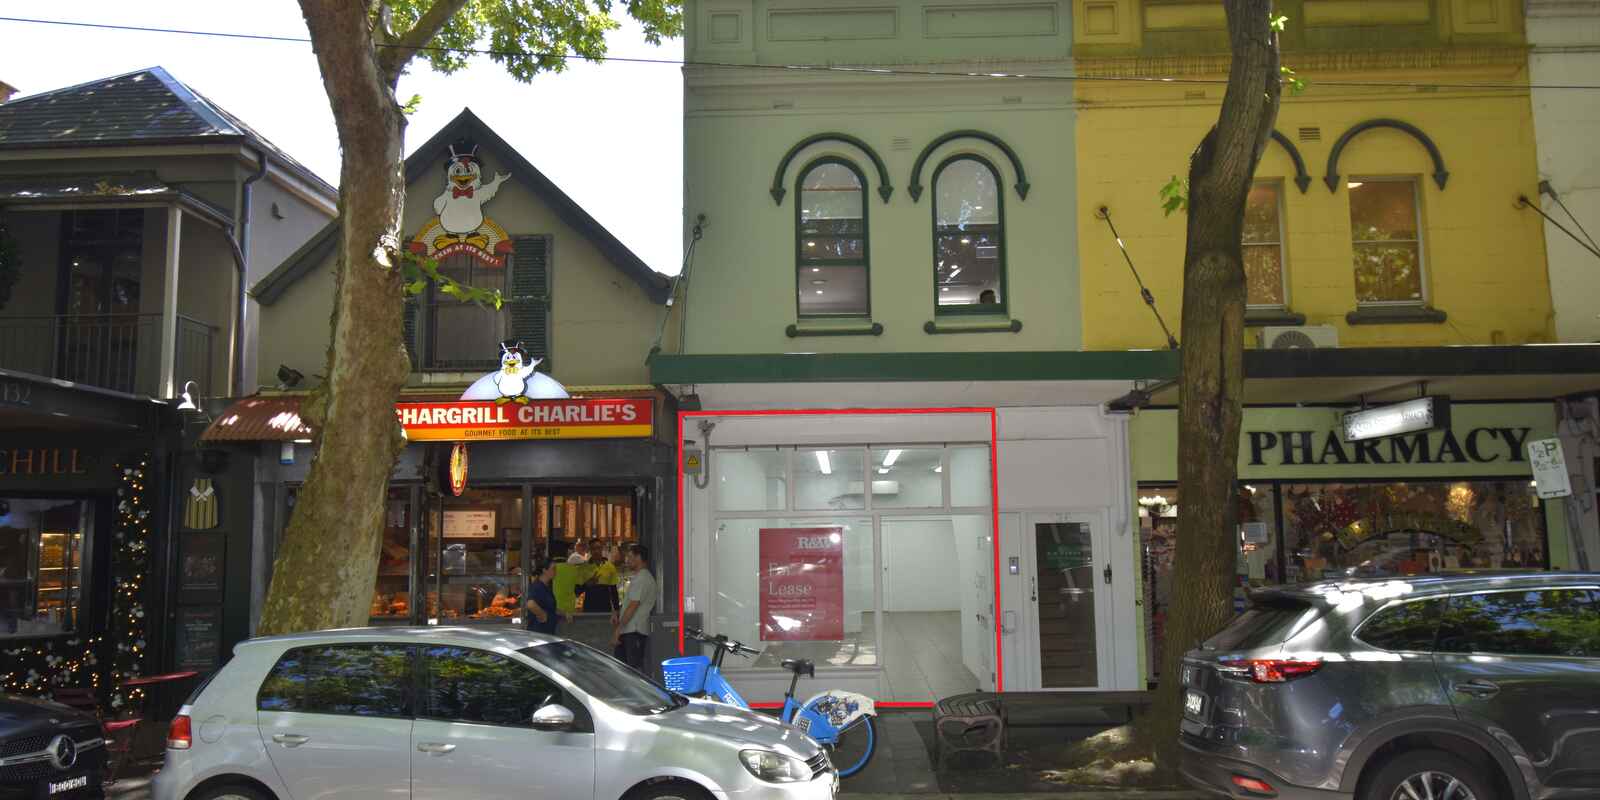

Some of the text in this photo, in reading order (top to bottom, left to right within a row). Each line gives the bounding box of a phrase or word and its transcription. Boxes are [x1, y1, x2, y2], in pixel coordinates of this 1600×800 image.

[518, 404, 637, 424] CHARLIE'S
[464, 427, 561, 438] GOURMET FOOD AT ITS BEST
[1247, 426, 1532, 466] PHARMACY
[768, 581, 812, 597] Lease
